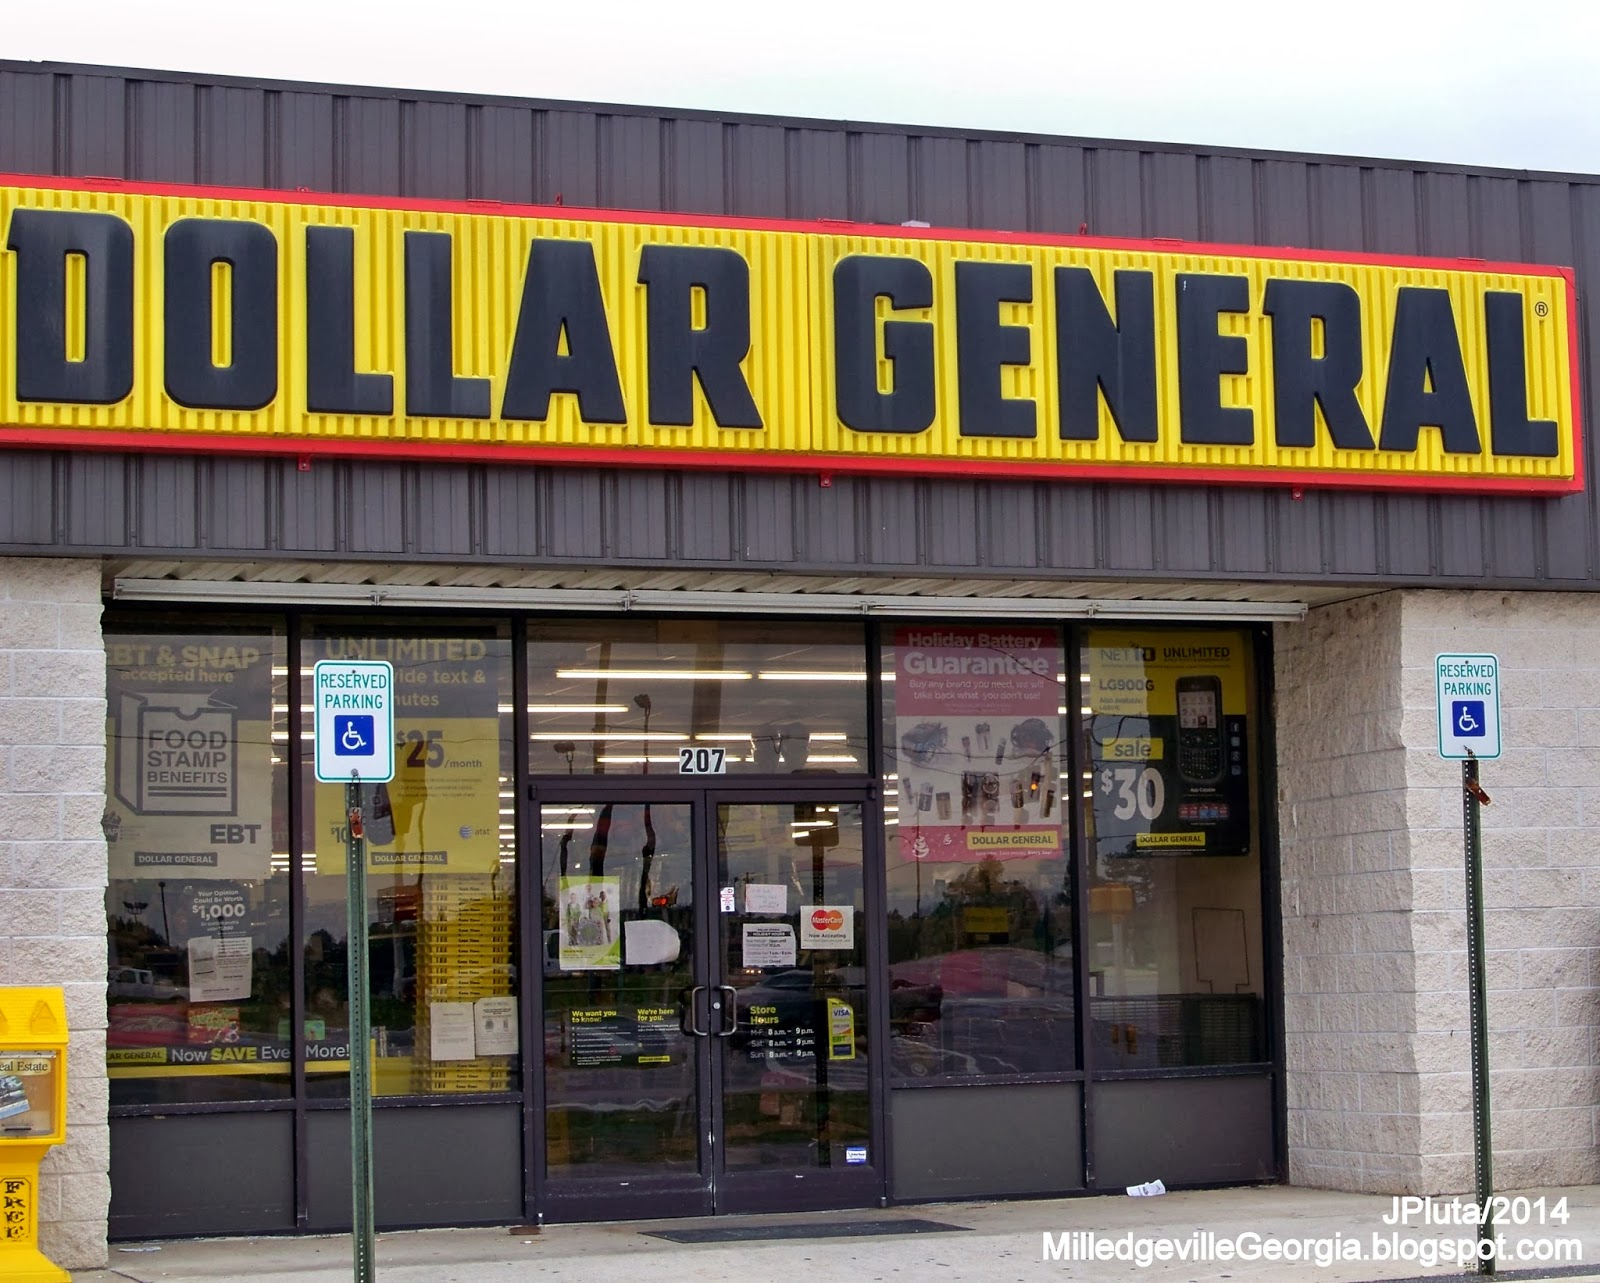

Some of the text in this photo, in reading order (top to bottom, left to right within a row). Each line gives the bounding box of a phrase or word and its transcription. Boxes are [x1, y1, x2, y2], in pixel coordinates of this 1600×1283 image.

[6, 208, 764, 430] DOLLAR
[833, 254, 1558, 457] GENERAL
[325, 637, 487, 661] UNLIMITED
[908, 632, 1042, 651] Holiday Battery
[156, 644, 177, 667] &
[181, 645, 260, 669] SNAP
[1163, 647, 1230, 658] UNLIMITED
[904, 651, 1049, 675] Guarantee
[121, 668, 234, 683] accepted here
[433, 669, 469, 684] text
[474, 669, 486, 684] &
[1440, 664, 1494, 678] RESERVED
[320, 673, 387, 689] RESERVED
[909, 680, 926, 690] Buy
[928, 682, 943, 690] any
[946, 679, 970, 688] brand
[973, 682, 990, 690] you
[1100, 679, 1155, 691] LG900G
[1444, 682, 1491, 695] PARKING
[325, 694, 383, 709] PARKING
[914, 691, 932, 699] take
[935, 691, 955, 699] back
[957, 691, 979, 699] what
[1000, 691, 1023, 699] don't
[148, 729, 227, 750] FOOD
[1114, 739, 1152, 758] sale
[147, 751, 226, 768] STAMP
[680, 749, 725, 773] 207
[147, 771, 227, 784] BENEFITS
[1101, 768, 1165, 821] $30
[210, 824, 261, 844] EBT
[972, 835, 1053, 845] DOLLAR GENERAL
[139, 855, 213, 863] DOLLAR GENERAL
[408, 854, 444, 862] GENERAL
[214, 889, 239, 897] Opinion
[192, 903, 246, 921] $1,000
[603, 1010, 617, 1019] you
[750, 1006, 776, 1014] Store
[750, 1016, 779, 1025] Hours
[768, 1028, 773, 1036] 8
[108, 1044, 350, 1062] AR GENERAL Now SAVE Eve More!
[0, 1061, 48, 1072] eal Estate
